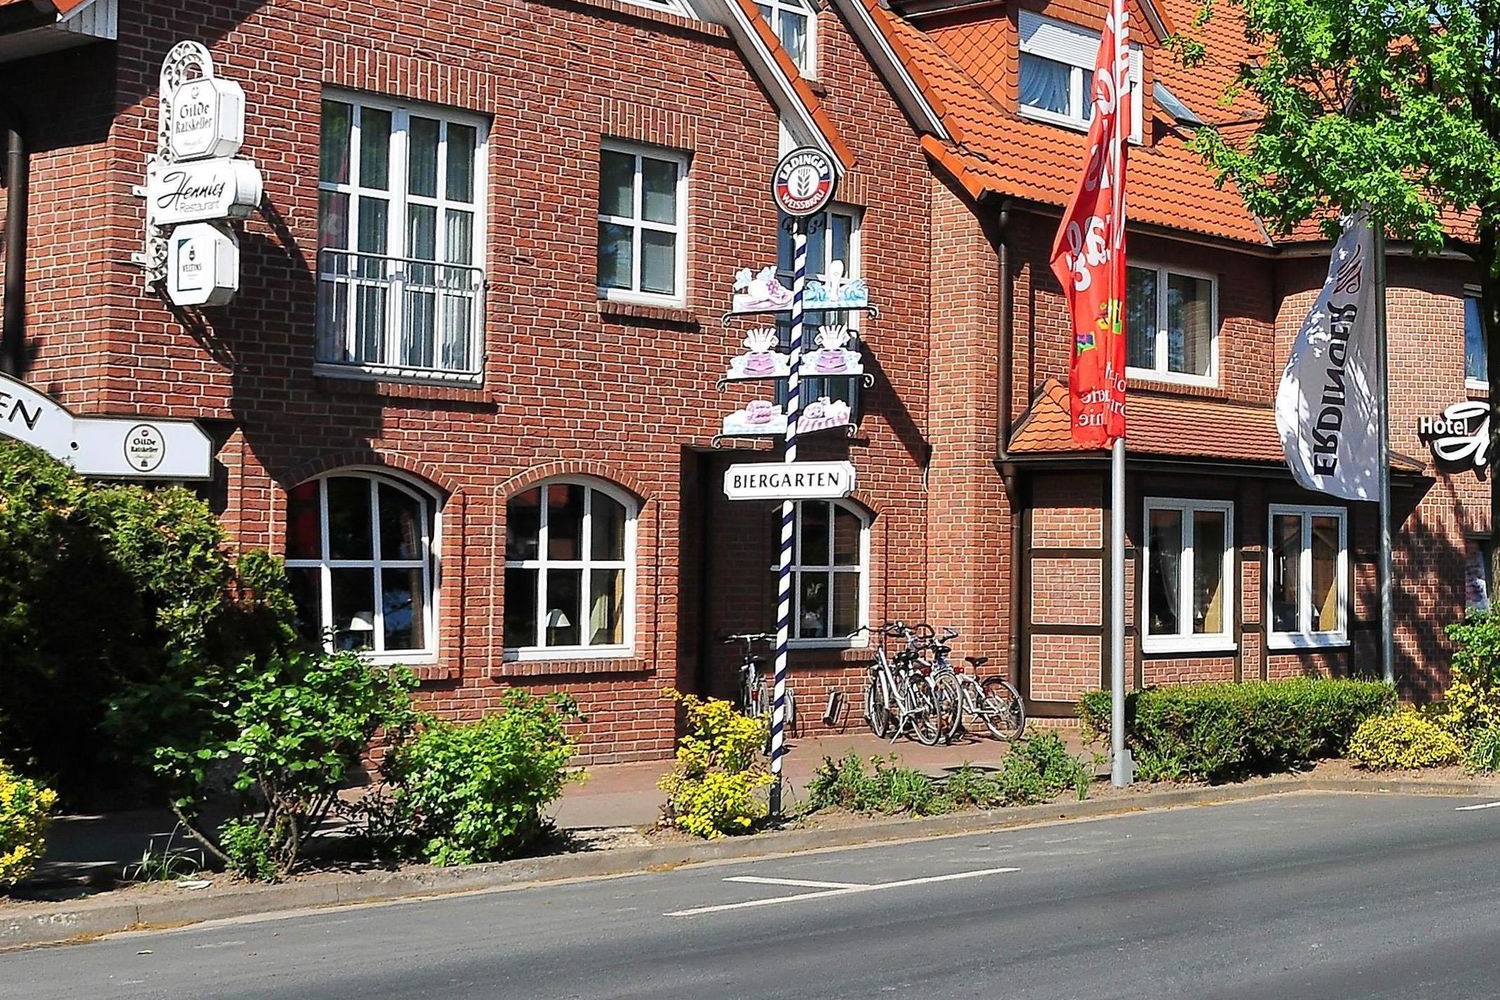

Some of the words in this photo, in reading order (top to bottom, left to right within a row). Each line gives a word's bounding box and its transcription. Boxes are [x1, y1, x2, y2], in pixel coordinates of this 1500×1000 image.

[780, 154, 828, 181] ERDINGER
[157, 171, 226, 211] Hennies
[1420, 416, 1468, 436] Hotel
[733, 472, 840, 489] BIERGARTEN
